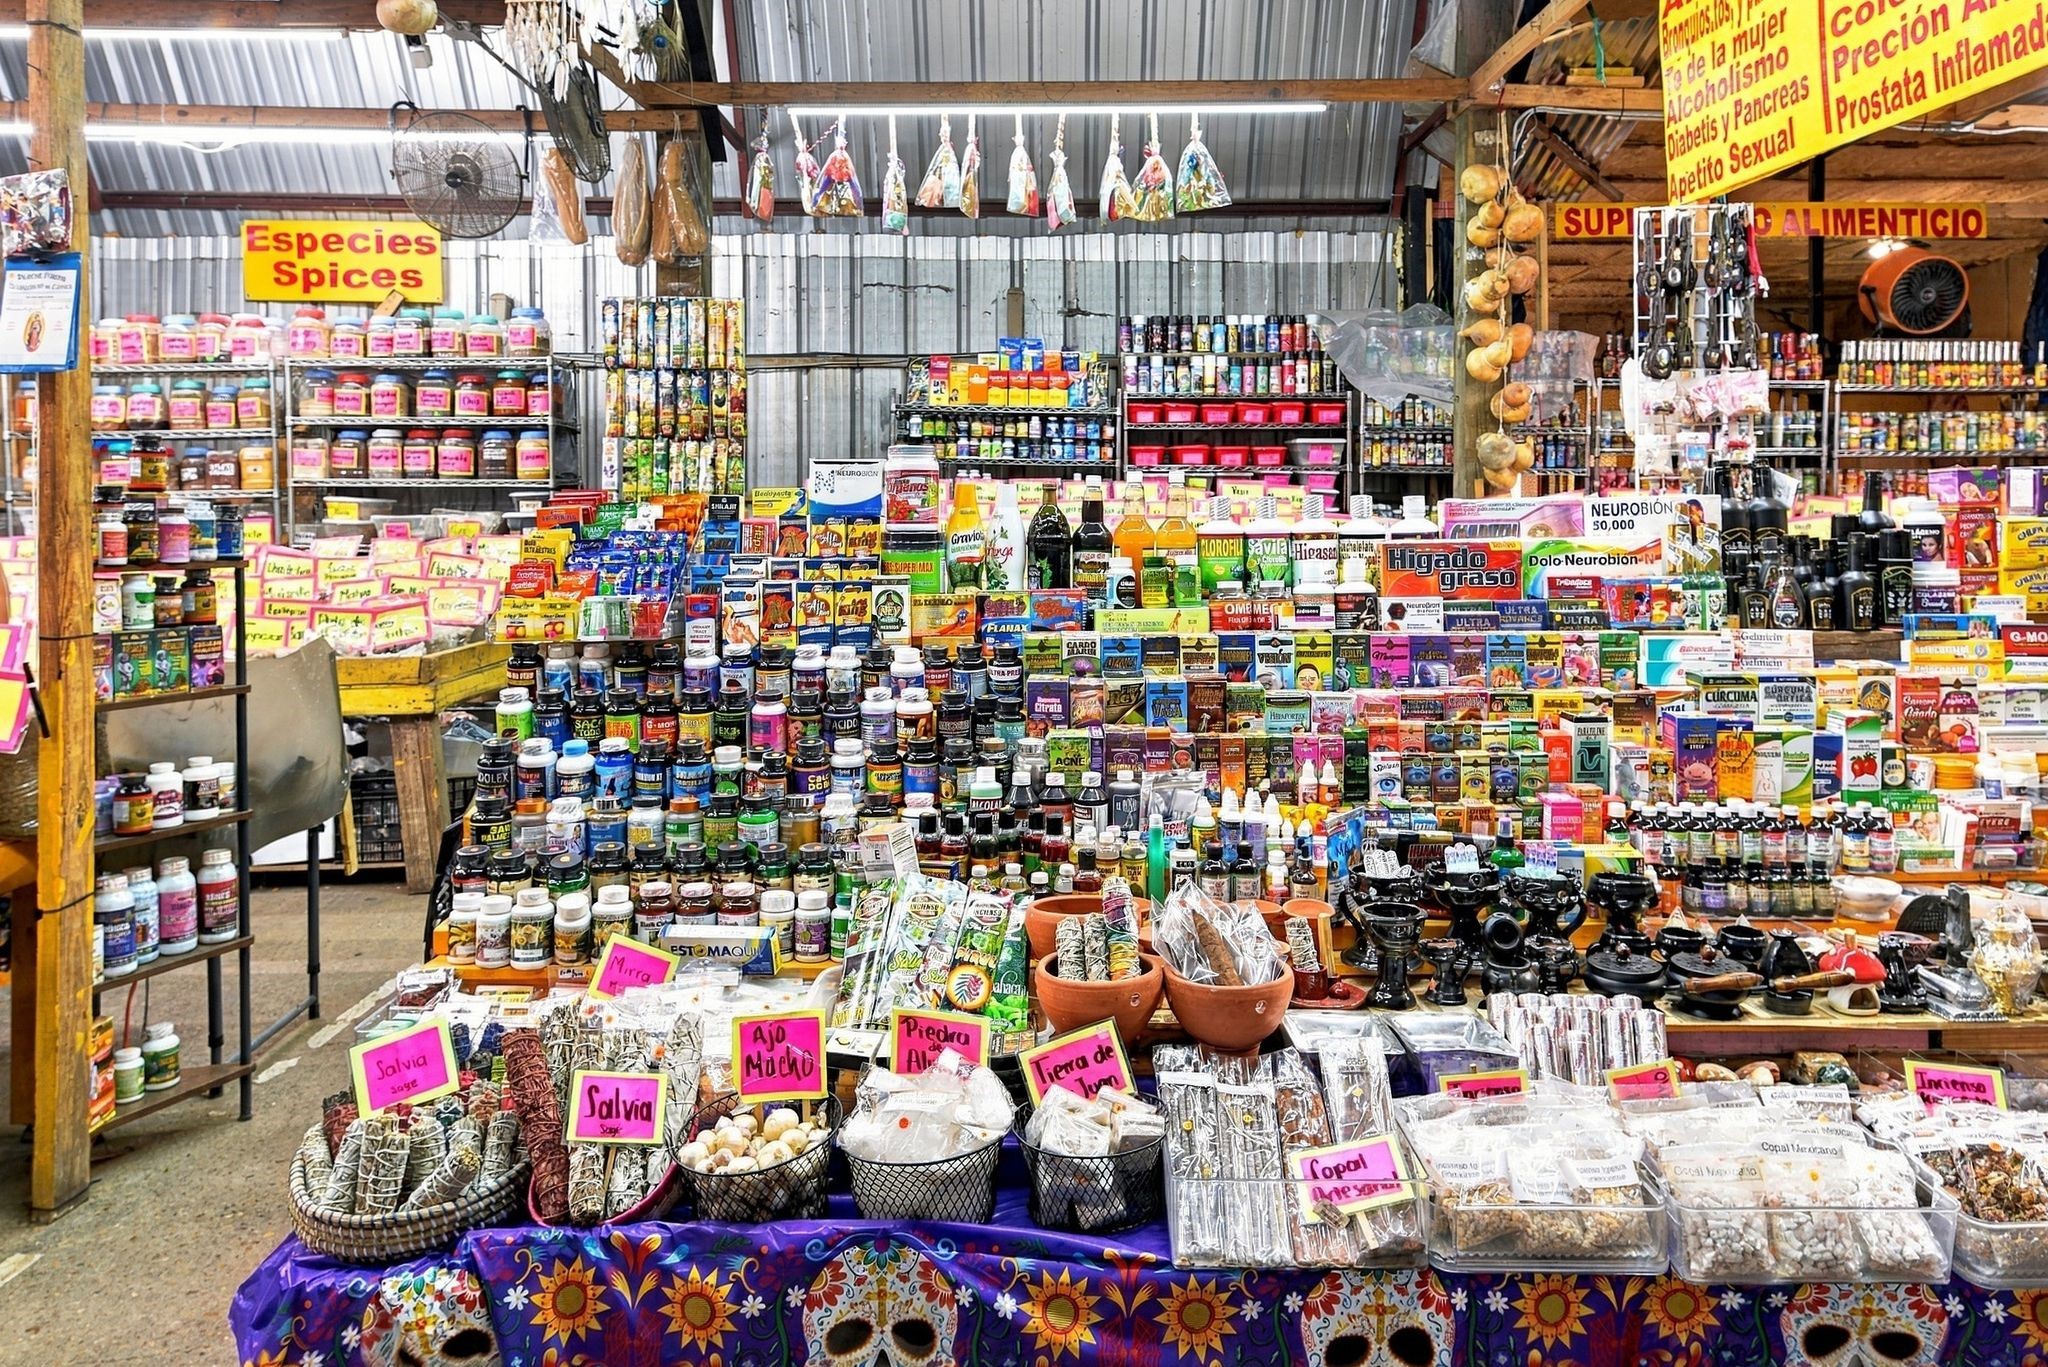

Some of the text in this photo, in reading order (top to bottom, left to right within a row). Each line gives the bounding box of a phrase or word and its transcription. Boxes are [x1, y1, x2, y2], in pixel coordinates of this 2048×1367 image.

[1687, 53, 1706, 83] de
[1711, 41, 1726, 70] la
[1732, 7, 1787, 59] mujer
[1833, 3, 1949, 84] Preción
[1836, 2, 2048, 134] Prostata Inflamad
[1666, 46, 1789, 129] Alcoholismo
[1667, 75, 1809, 161] Diabetis y Pancreas
[1669, 116, 1796, 206] Apetito Sexual
[1782, 207, 1984, 237] ALIMENTICIO
[246, 225, 437, 259] Especies
[273, 261, 423, 294] Spices
[1591, 499, 1673, 517] NEUROBIÓN
[1593, 520, 1635, 531] 50,000
[1387, 547, 1488, 576] Higado
[1439, 570, 1517, 593] graso
[986, 624, 1029, 633] FLANAX
[1456, 618, 1491, 627] ULTRA
[1055, 758, 1086, 766] ACNE
[874, 850, 881, 860] E
[609, 955, 652, 982] Mirra
[752, 1021, 786, 1052] Ajo
[901, 1016, 971, 1046] Piedra
[376, 1054, 428, 1081] Salvia
[1030, 1044, 1114, 1085] Tierra de
[1916, 1071, 1987, 1094] Incienso
[584, 1084, 652, 1122] Salvia
[1761, 1141, 1789, 1155] Copal
[1310, 1153, 1368, 1180] Copal
